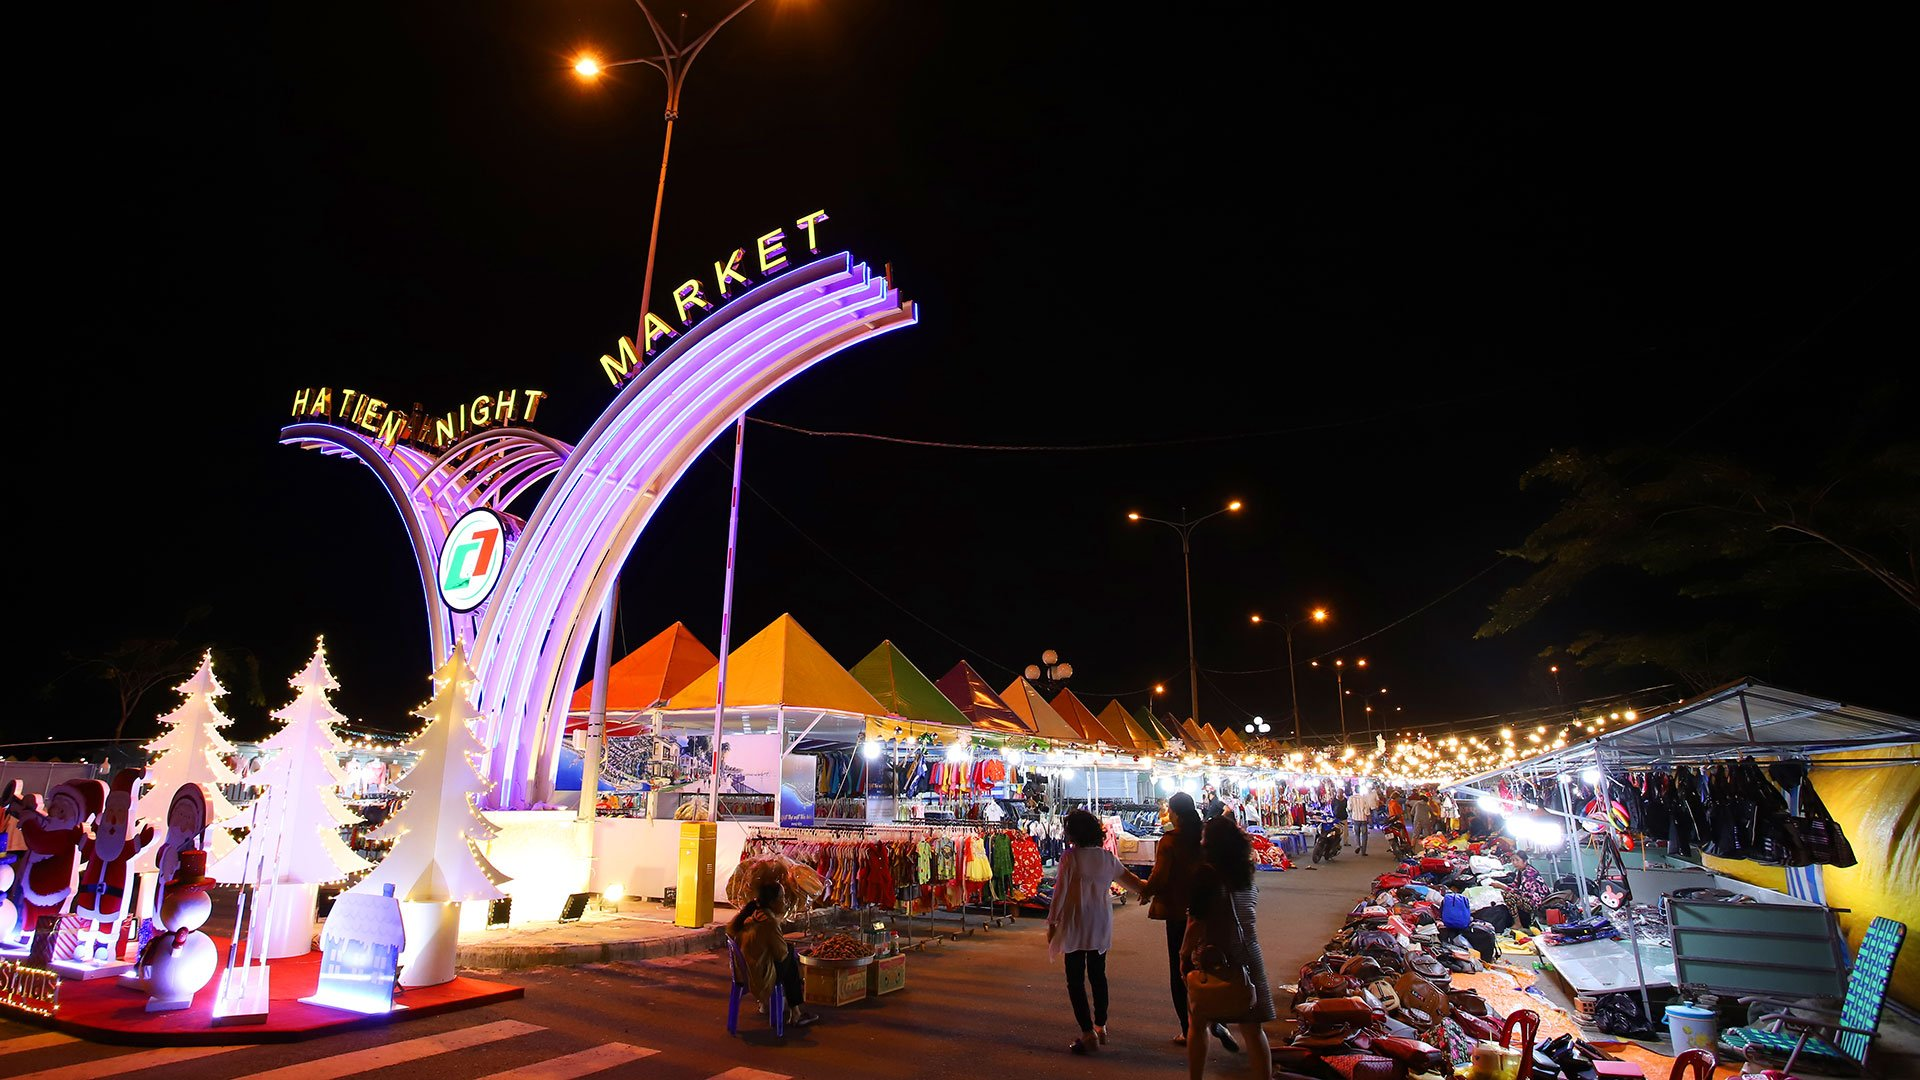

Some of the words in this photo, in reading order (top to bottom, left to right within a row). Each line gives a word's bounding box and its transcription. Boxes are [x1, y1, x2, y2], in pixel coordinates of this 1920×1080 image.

[291, 386, 329, 418] HA
[339, 388, 402, 448] TIEN
[436, 388, 543, 447] NIGHT
[599, 208, 827, 389] MARKET
